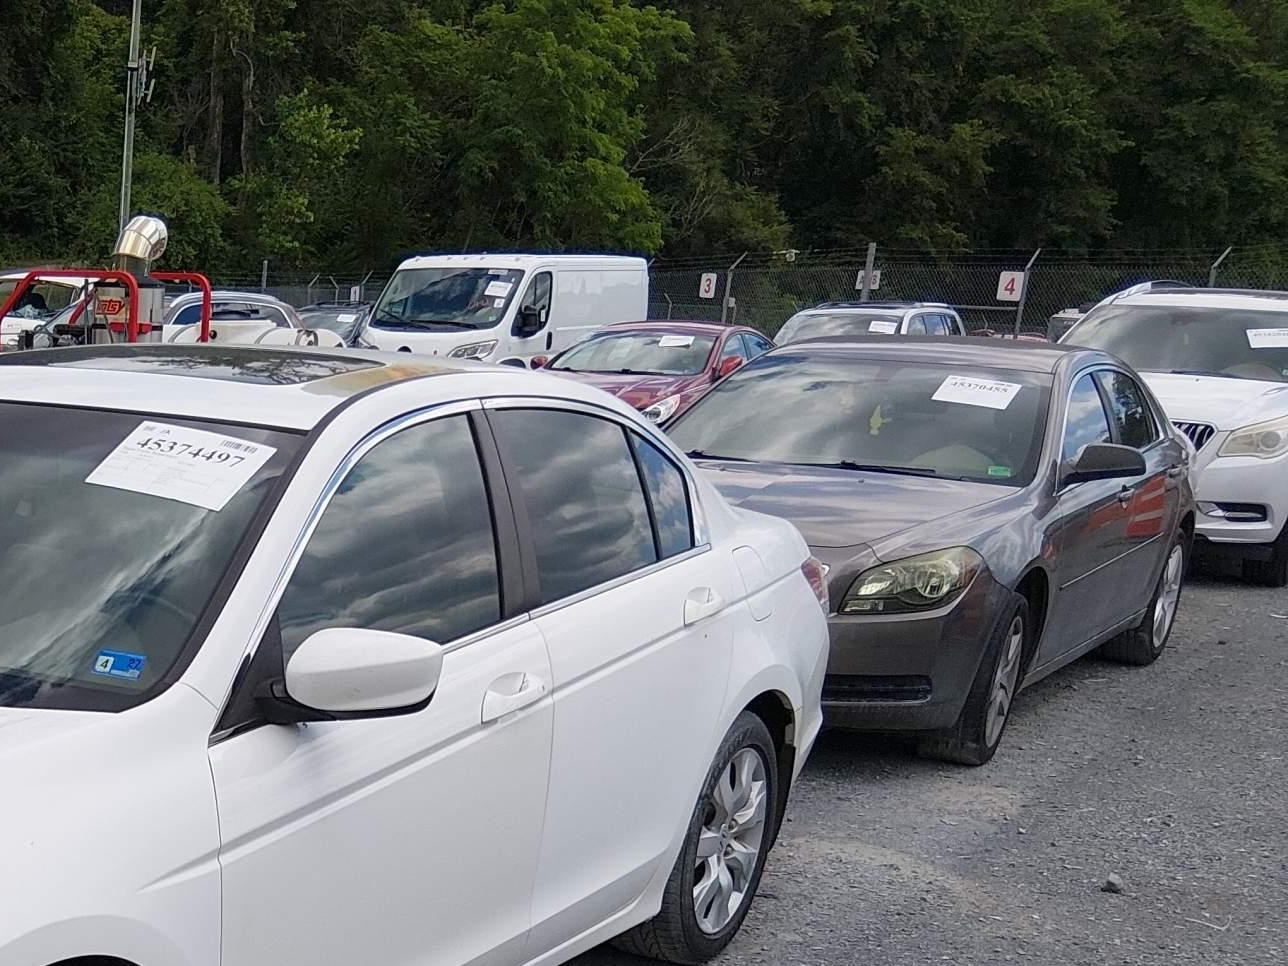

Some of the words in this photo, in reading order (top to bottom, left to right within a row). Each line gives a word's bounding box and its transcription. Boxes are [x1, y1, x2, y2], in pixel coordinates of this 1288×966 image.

[703, 277, 712, 294] 3
[1004, 277, 1016, 296] 4
[136, 436, 246, 469] 45374497
